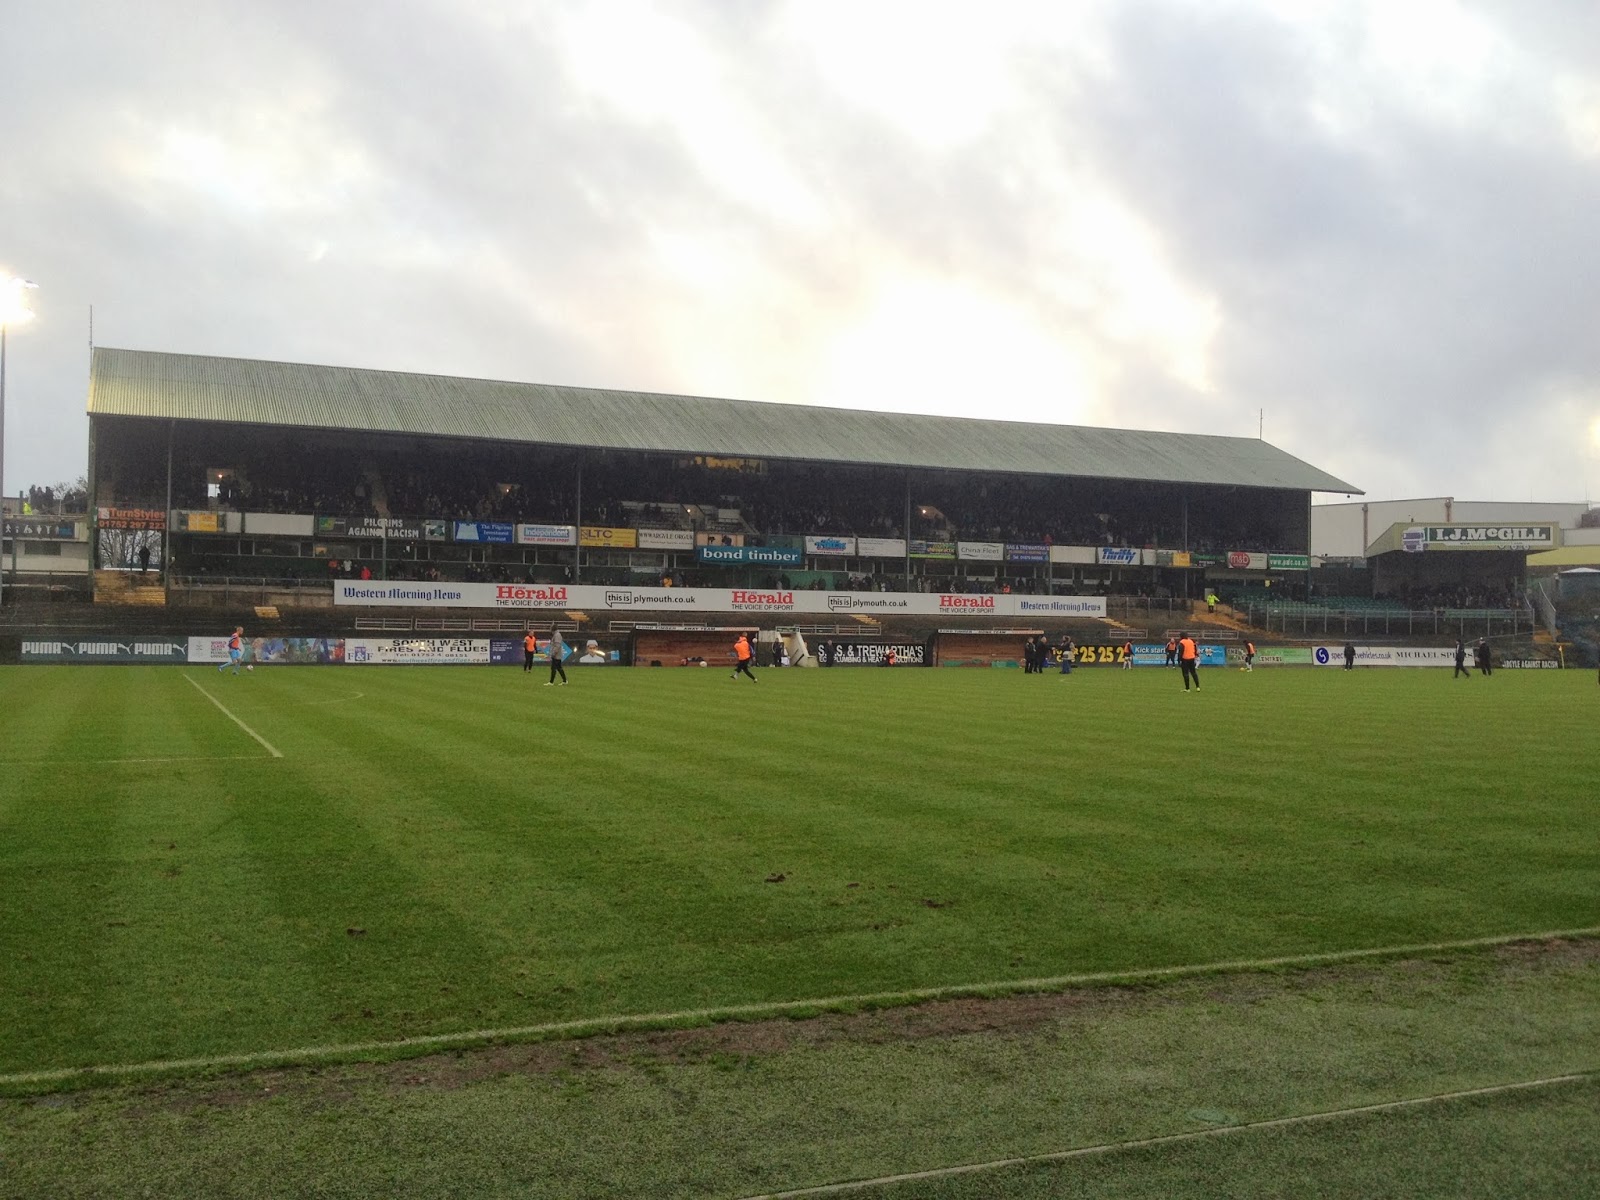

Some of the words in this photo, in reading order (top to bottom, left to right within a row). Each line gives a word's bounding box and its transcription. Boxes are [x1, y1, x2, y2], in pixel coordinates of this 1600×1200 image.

[110, 508, 166, 520] TurnStyles
[364, 518, 403, 528] PILGRIMS
[348, 527, 386, 538] AGAINS
[388, 530, 419, 538] RACISM
[588, 530, 612, 538] LTC
[704, 548, 742, 559] bond
[748, 550, 798, 561] timber
[344, 588, 386, 598] Western
[388, 588, 432, 600] Morning
[434, 590, 461, 600] News
[496, 586, 568, 600] Herald
[732, 591, 794, 604] Herald
[634, 595, 696, 604] plymouth.co.uk
[940, 596, 995, 608] Herald
[1020, 601, 1050, 610] Western
[1051, 602, 1080, 612] Morning
[1082, 602, 1100, 611] News
[22, 642, 62, 654] PUMA
[79, 643, 118, 654] PUMA
[135, 644, 172, 655] PUMA
[847, 645, 854, 656] &
[856, 645, 923, 657] TREWARTHA'S
[1080, 646, 1096, 662] 25
[1098, 646, 1114, 662] 25
